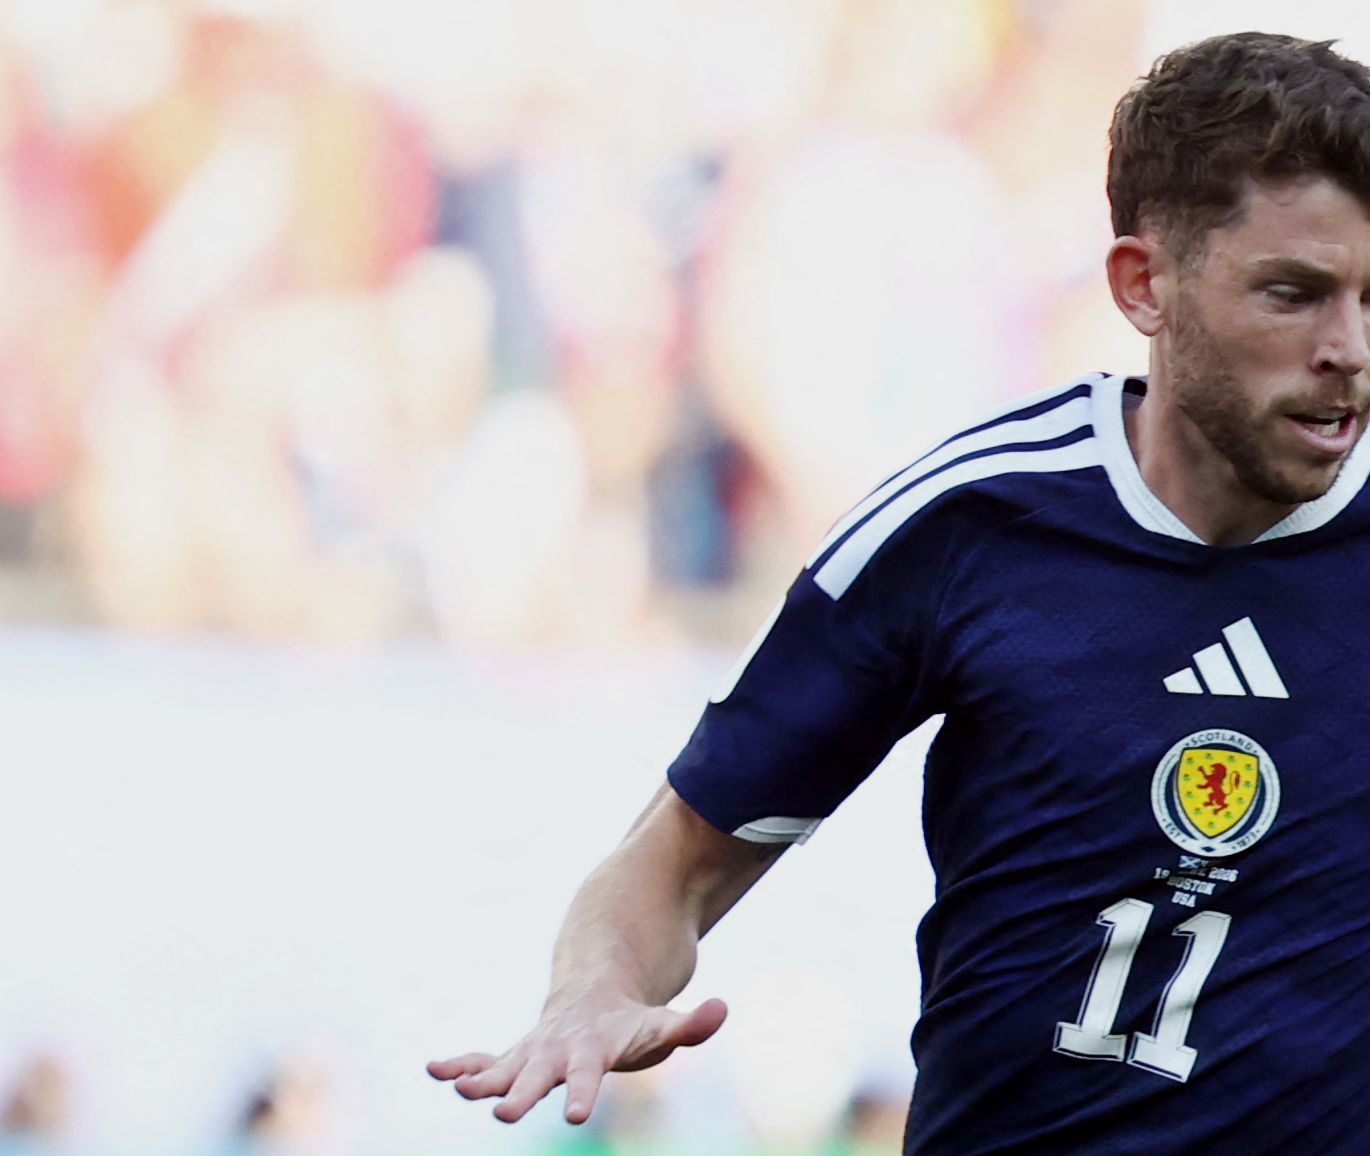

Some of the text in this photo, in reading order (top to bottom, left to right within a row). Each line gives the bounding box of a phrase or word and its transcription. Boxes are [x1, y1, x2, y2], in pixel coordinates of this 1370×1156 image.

[1191, 732, 1253, 750] SCOTLAND
[1172, 891, 1197, 908] USA
[1053, 898, 1232, 1083] 11
